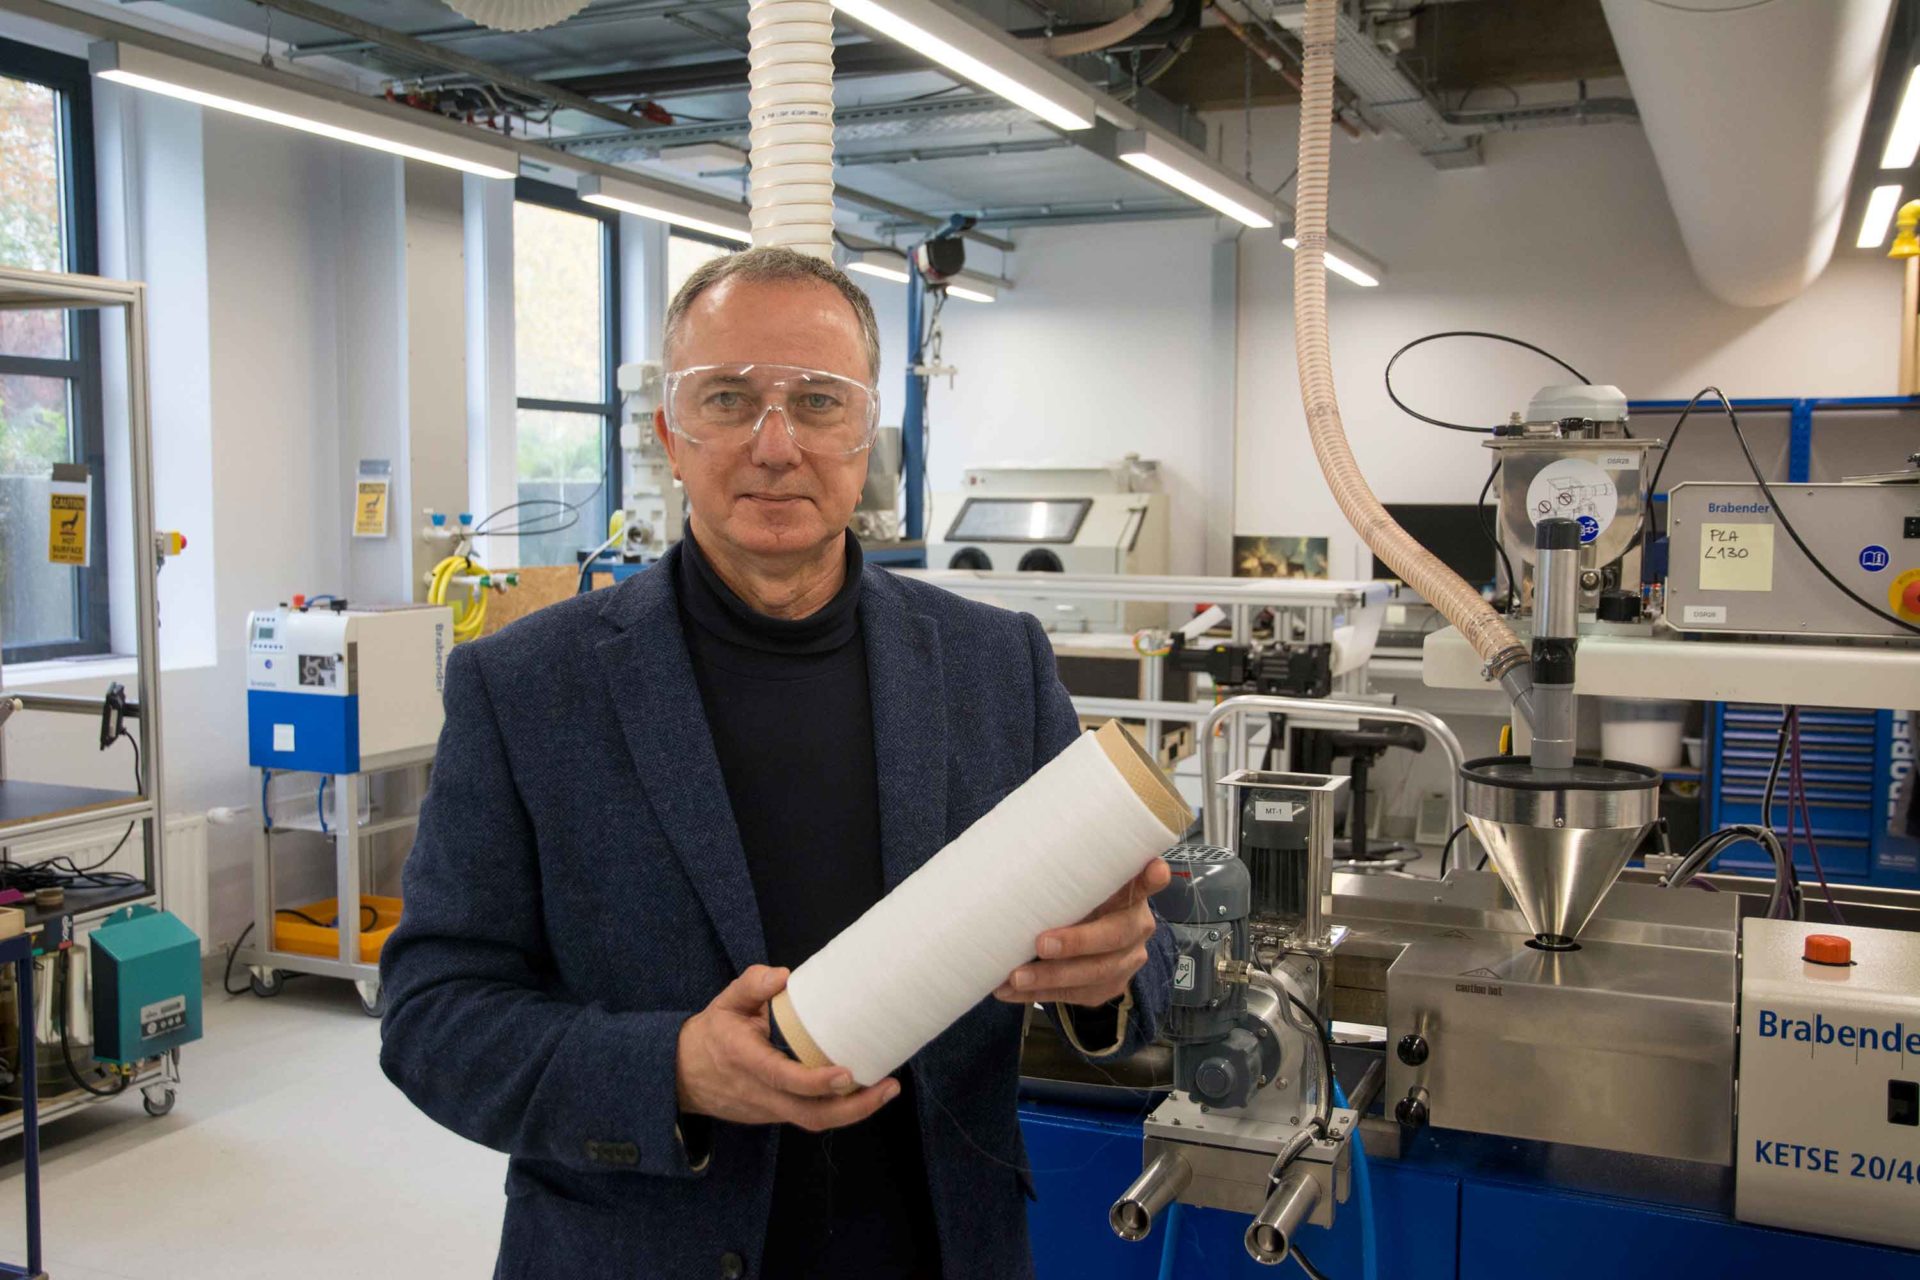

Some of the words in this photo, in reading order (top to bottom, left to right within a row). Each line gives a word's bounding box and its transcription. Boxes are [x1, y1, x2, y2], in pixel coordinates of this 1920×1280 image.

[1708, 502, 1770, 514] Brabender
[1710, 528, 1739, 542] PLA
[1704, 546, 1749, 559] L130
[435, 623, 444, 692] Brabender
[1456, 984, 1486, 995] caution
[1488, 985, 1503, 997] hot
[1759, 1010, 1920, 1055] Brabende
[1755, 1139, 1839, 1174] KETSE
[1850, 1153, 1920, 1185] 20/4
